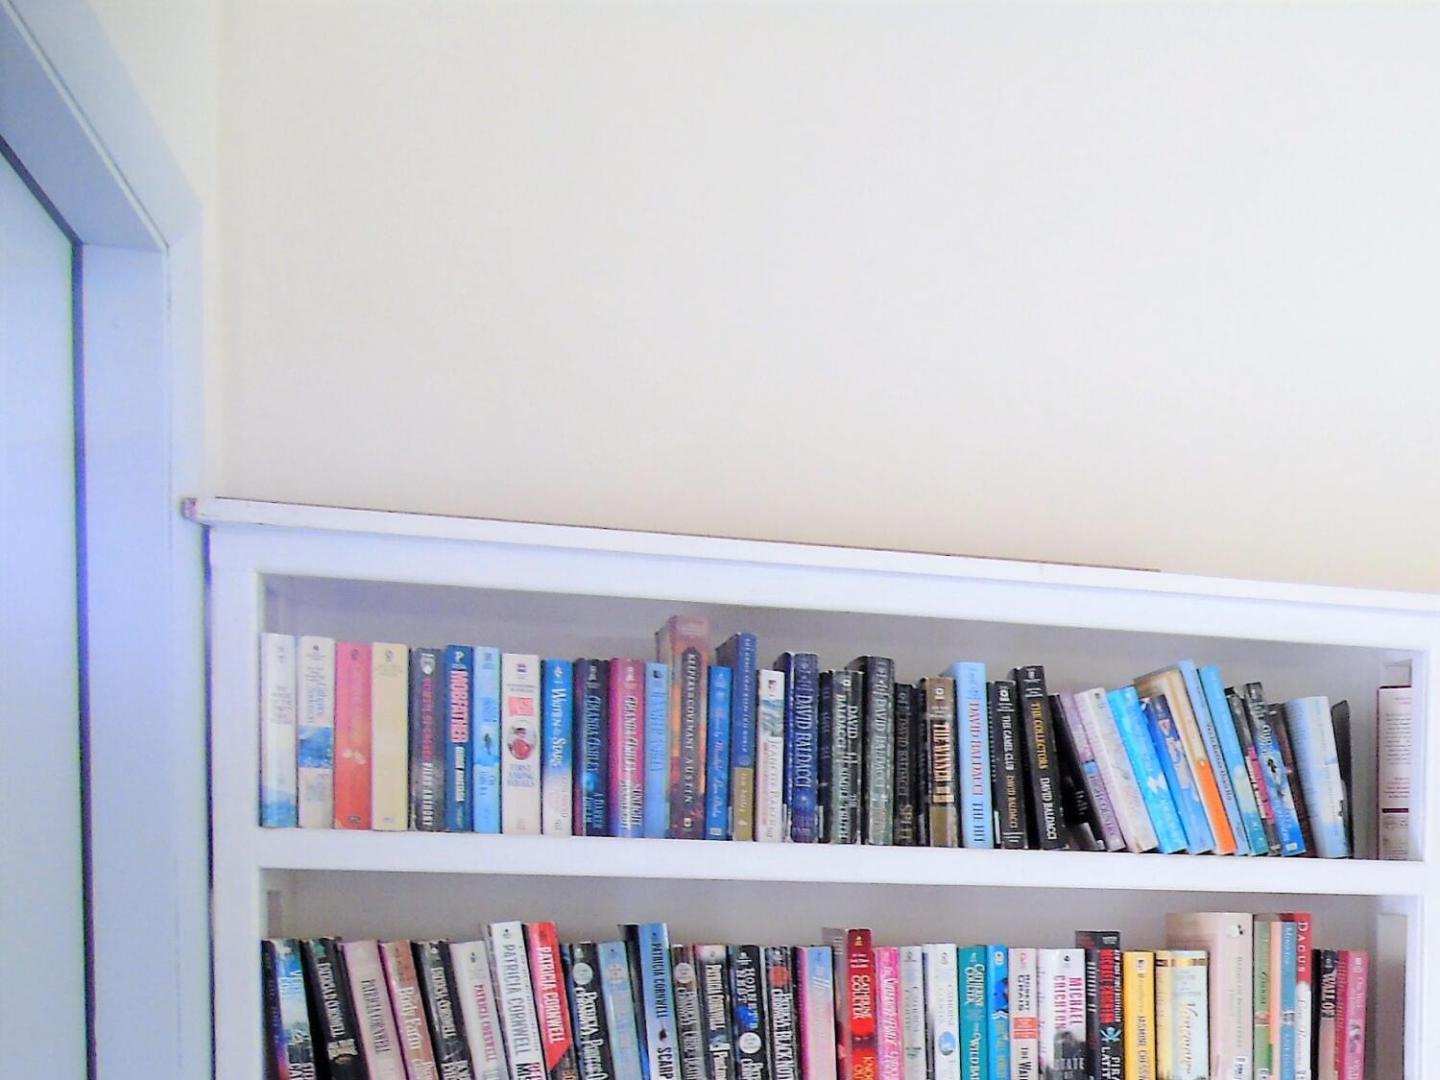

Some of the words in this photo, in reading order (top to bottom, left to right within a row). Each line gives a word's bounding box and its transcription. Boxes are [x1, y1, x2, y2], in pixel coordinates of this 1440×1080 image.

[451, 671, 468, 742] MOBFATHER
[796, 695, 812, 729] DAVID
[836, 694, 846, 748] BALDACCI
[848, 706, 857, 738] DAVID
[875, 697, 886, 732] DAVID
[969, 703, 981, 738] DAVID
[1001, 715, 1010, 729] THE
[1031, 702, 1042, 718] THE
[685, 700, 695, 749] COVENANT
[898, 718, 909, 746] DAVID
[933, 722, 950, 744] THE
[1002, 730, 1012, 752] CAMEL
[796, 732, 812, 787] BALDACCI
[875, 735, 886, 788] BALDACCI
[1032, 719, 1048, 769] COLLECTORS
[934, 744, 952, 782] WINNER
[971, 741, 982, 796] BALDACCI
[1004, 753, 1014, 771] CLUB
[684, 758, 693, 803] AUSTIN
[1006, 775, 1015, 796] DAVID
[1040, 778, 1052, 801] DAVID
[972, 801, 983, 822] THE
[1007, 797, 1018, 829] BALDACCI
[1043, 803, 1057, 840] BALDACCI
[973, 825, 984, 842] HIT
[503, 944, 520, 994] PATRICIA
[536, 947, 557, 990] PATRICIA
[651, 943, 663, 976] PATRICIA
[398, 987, 417, 1018] Body
[653, 978, 668, 1018] CORNWELL
[1069, 977, 1083, 1024] MICHAEL
[406, 1019, 424, 1050] Farm
[509, 998, 531, 1056] CORNWELL
[543, 992, 564, 1044] CORNWELL
[774, 1031, 791, 1059] BLACK
